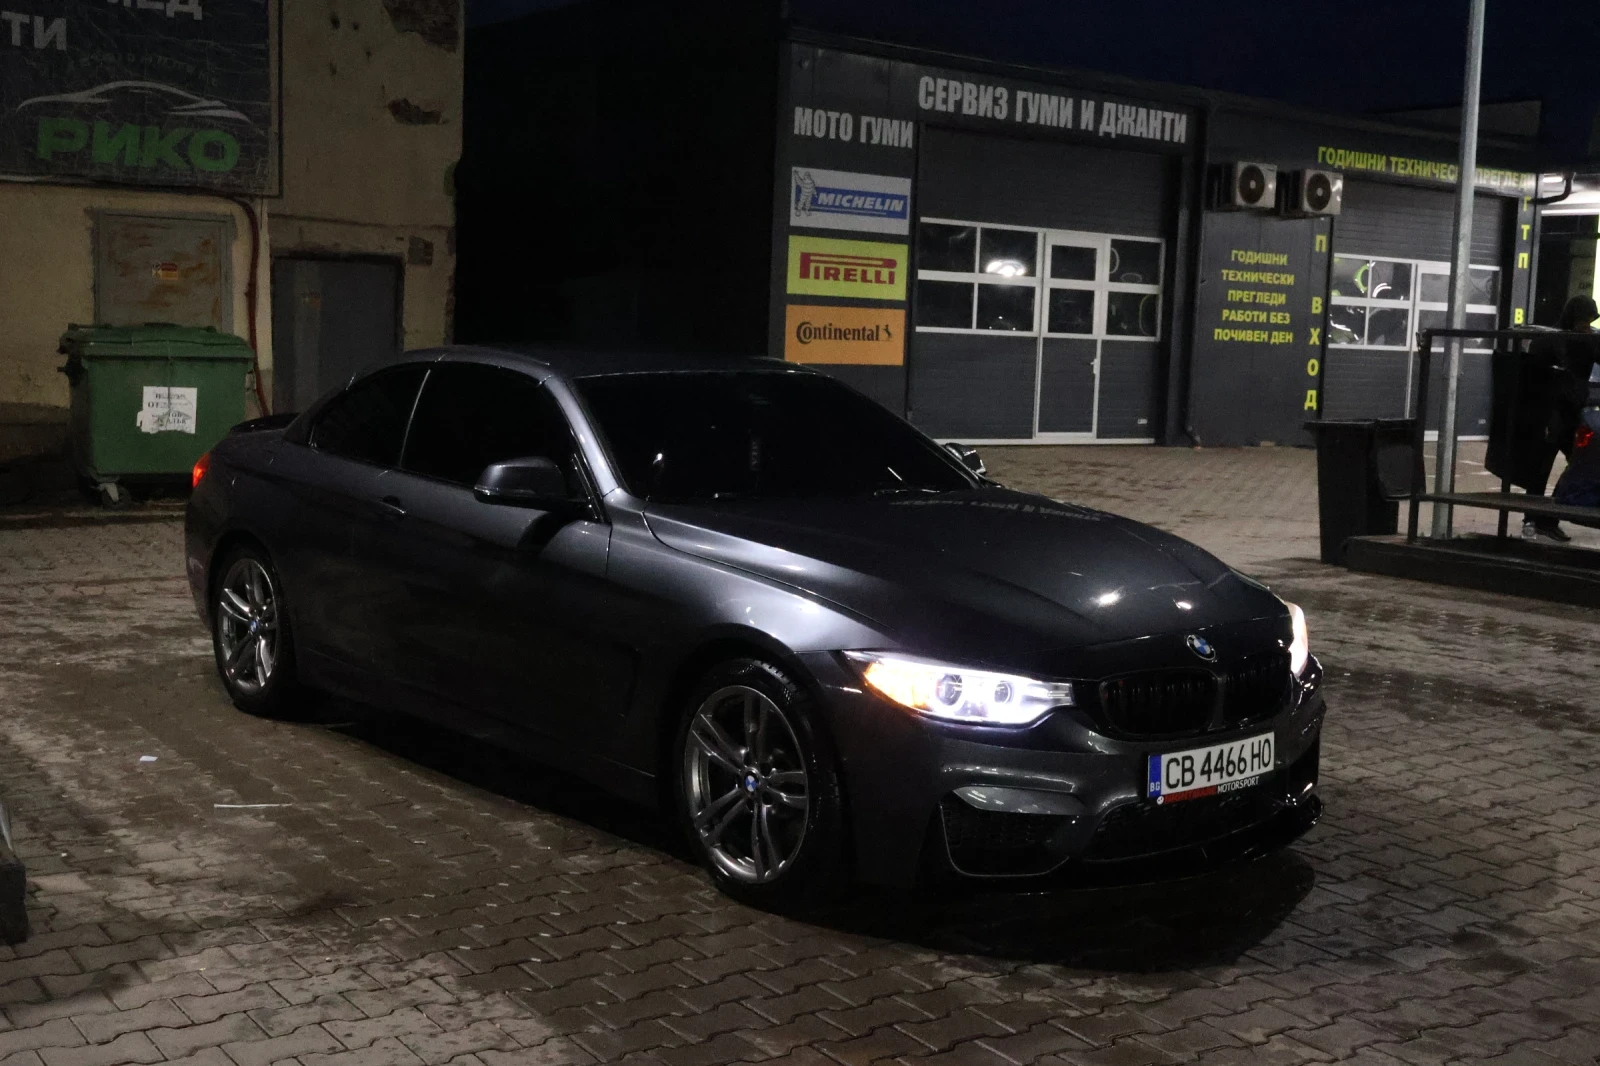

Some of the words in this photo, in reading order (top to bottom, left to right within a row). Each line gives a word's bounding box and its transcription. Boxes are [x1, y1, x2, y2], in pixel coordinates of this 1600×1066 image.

[918, 75, 1009, 120] СЕРВИЗ
[1015, 90, 1074, 129] ГУМИ
[1080, 99, 1095, 132] И
[1099, 102, 1188, 144] ДЖАНТИ
[794, 107, 853, 142] МОТО
[860, 115, 914, 149] ГУМИ
[37, 116, 240, 172] РИКО
[1318, 146, 1386, 172] ГОДИШНИ
[1390, 156, 1459, 184] ТЕХНИЧЕС
[817, 191, 904, 212] MICHELIN
[799, 252, 897, 285] PIRELLI
[1231, 250, 1288, 266] ГОДИШНИ
[1221, 269, 1295, 286] ТЕХНИЧЕСКИ
[1227, 289, 1287, 306] ПРЕГЛЕДИ
[1222, 309, 1267, 323] РАБОТИ
[1269, 311, 1291, 324] БЕЗ
[796, 321, 880, 344] Continental
[1213, 328, 1268, 343] ПОЧИВЕН
[1270, 331, 1294, 345] ДЕН
[1166, 755, 1195, 789] CB
[1201, 744, 1247, 782] 4466
[1149, 781, 1161, 793] BG
[1217, 775, 1260, 794] MOTORSPORT
